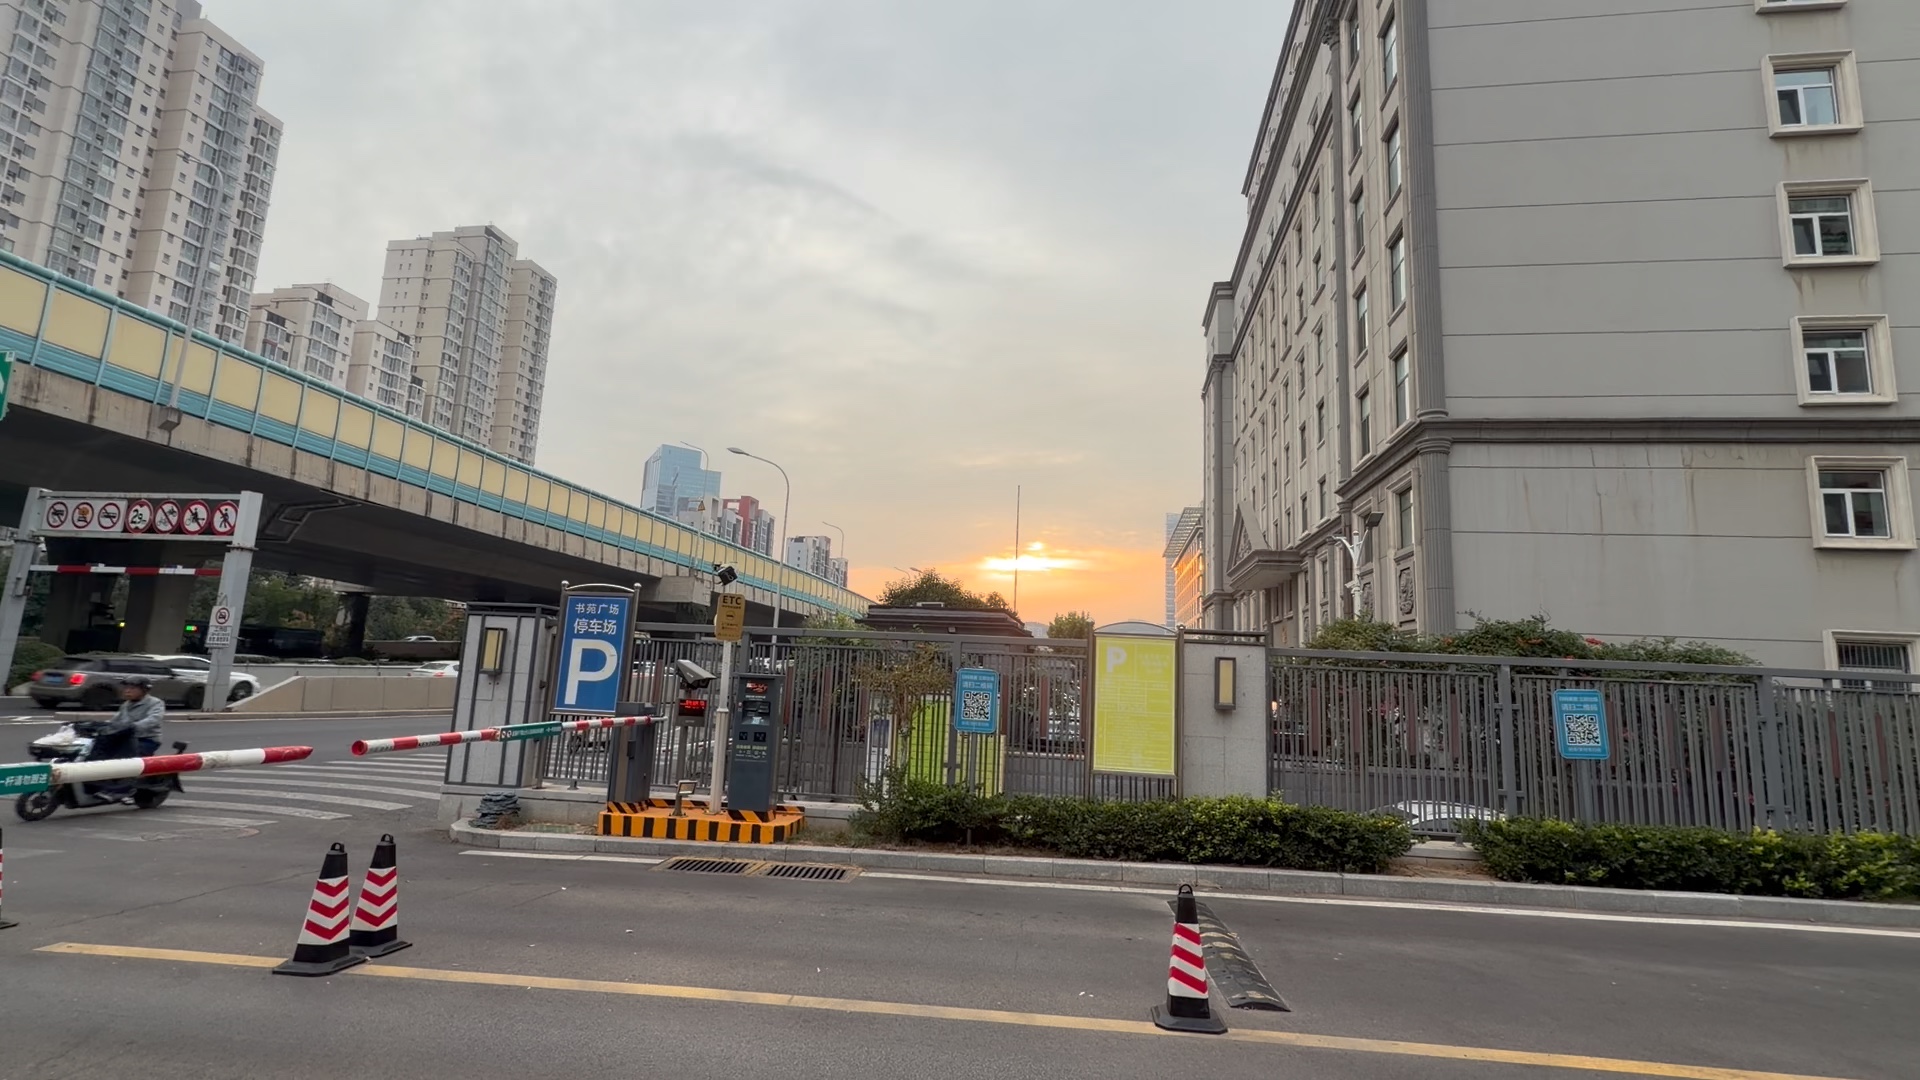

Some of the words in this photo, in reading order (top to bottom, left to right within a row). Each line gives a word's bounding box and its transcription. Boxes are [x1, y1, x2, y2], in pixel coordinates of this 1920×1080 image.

[575, 602, 620, 615] 书苑广场
[722, 595, 742, 606] ETC
[573, 618, 617, 635] 停车场
[1106, 646, 1128, 673] P
[564, 638, 618, 705] P
